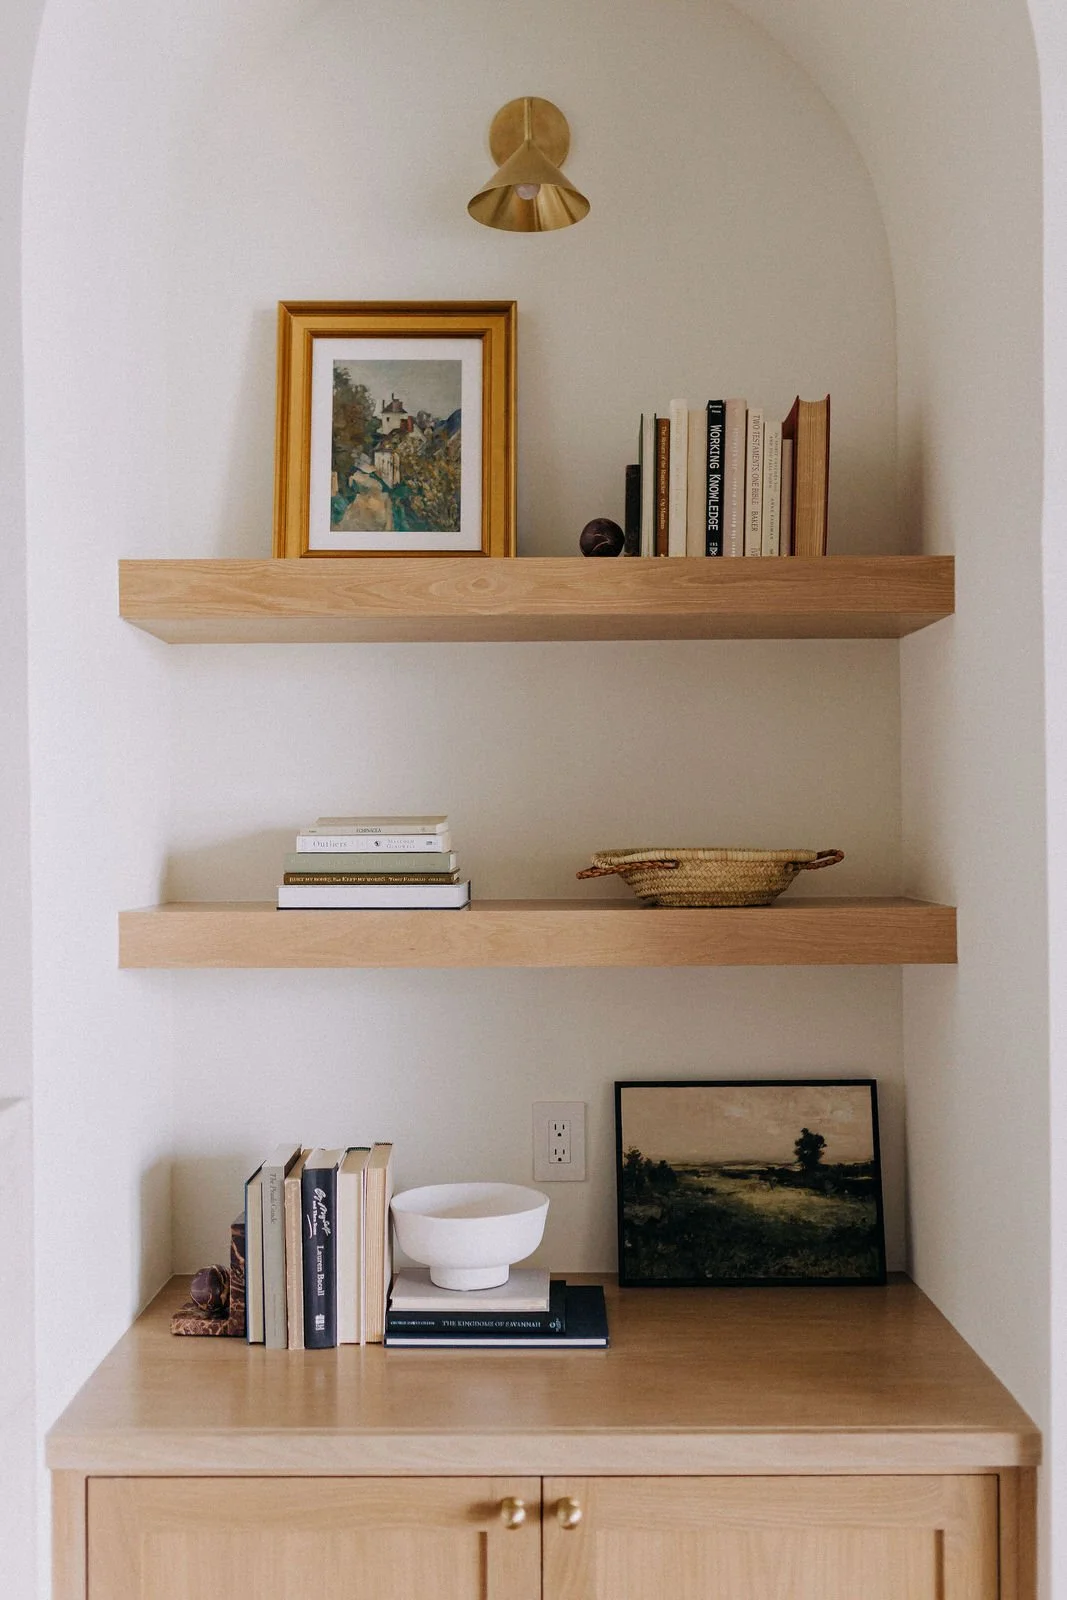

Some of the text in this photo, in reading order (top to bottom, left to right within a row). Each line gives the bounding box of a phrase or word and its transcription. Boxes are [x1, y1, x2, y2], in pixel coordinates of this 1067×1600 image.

[709, 424, 723, 469] WORKING
[708, 474, 722, 531] KNOWLEDGE
[751, 488, 759, 505] BIBLE
[751, 510, 759, 532] BAKER
[313, 839, 347, 848] Outliers
[317, 1245, 325, 1297] Lauren Bacall
